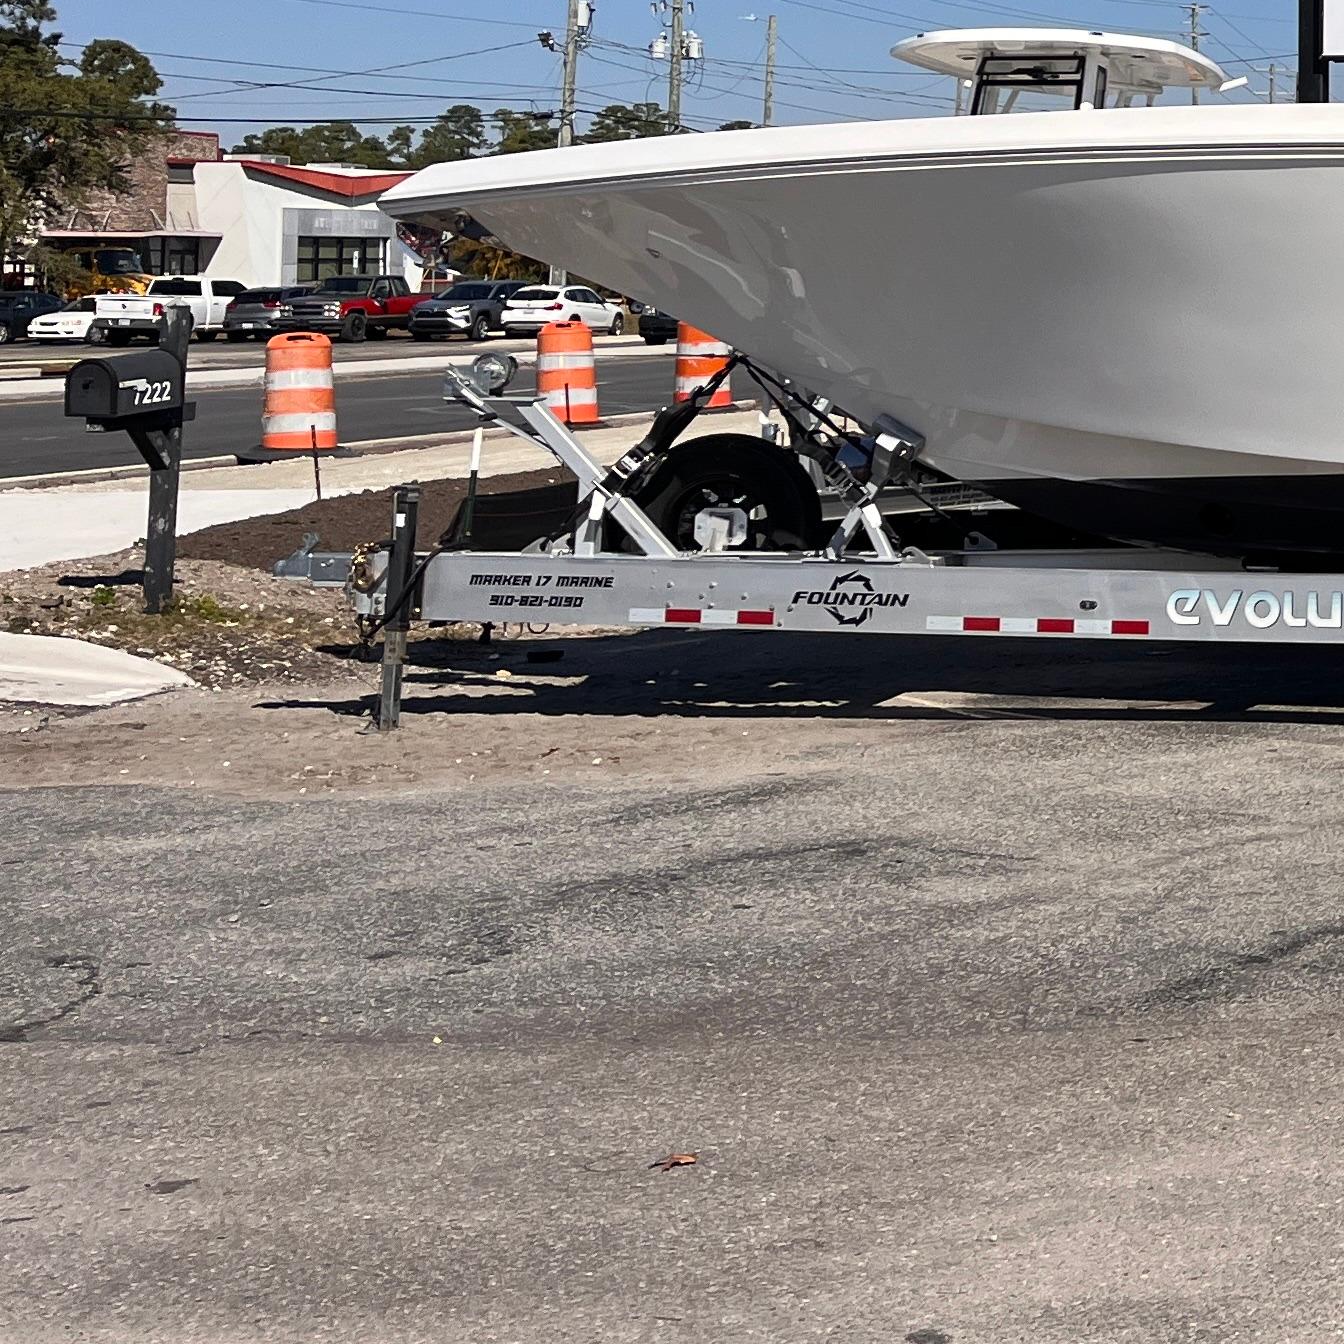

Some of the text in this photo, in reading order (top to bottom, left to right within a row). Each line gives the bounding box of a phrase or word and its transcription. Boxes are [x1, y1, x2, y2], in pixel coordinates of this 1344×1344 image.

[469, 574, 615, 588] MARKER 17 MARINE
[489, 594, 584, 607] 910-821-0190
[791, 591, 910, 607] FOUNTAIN
